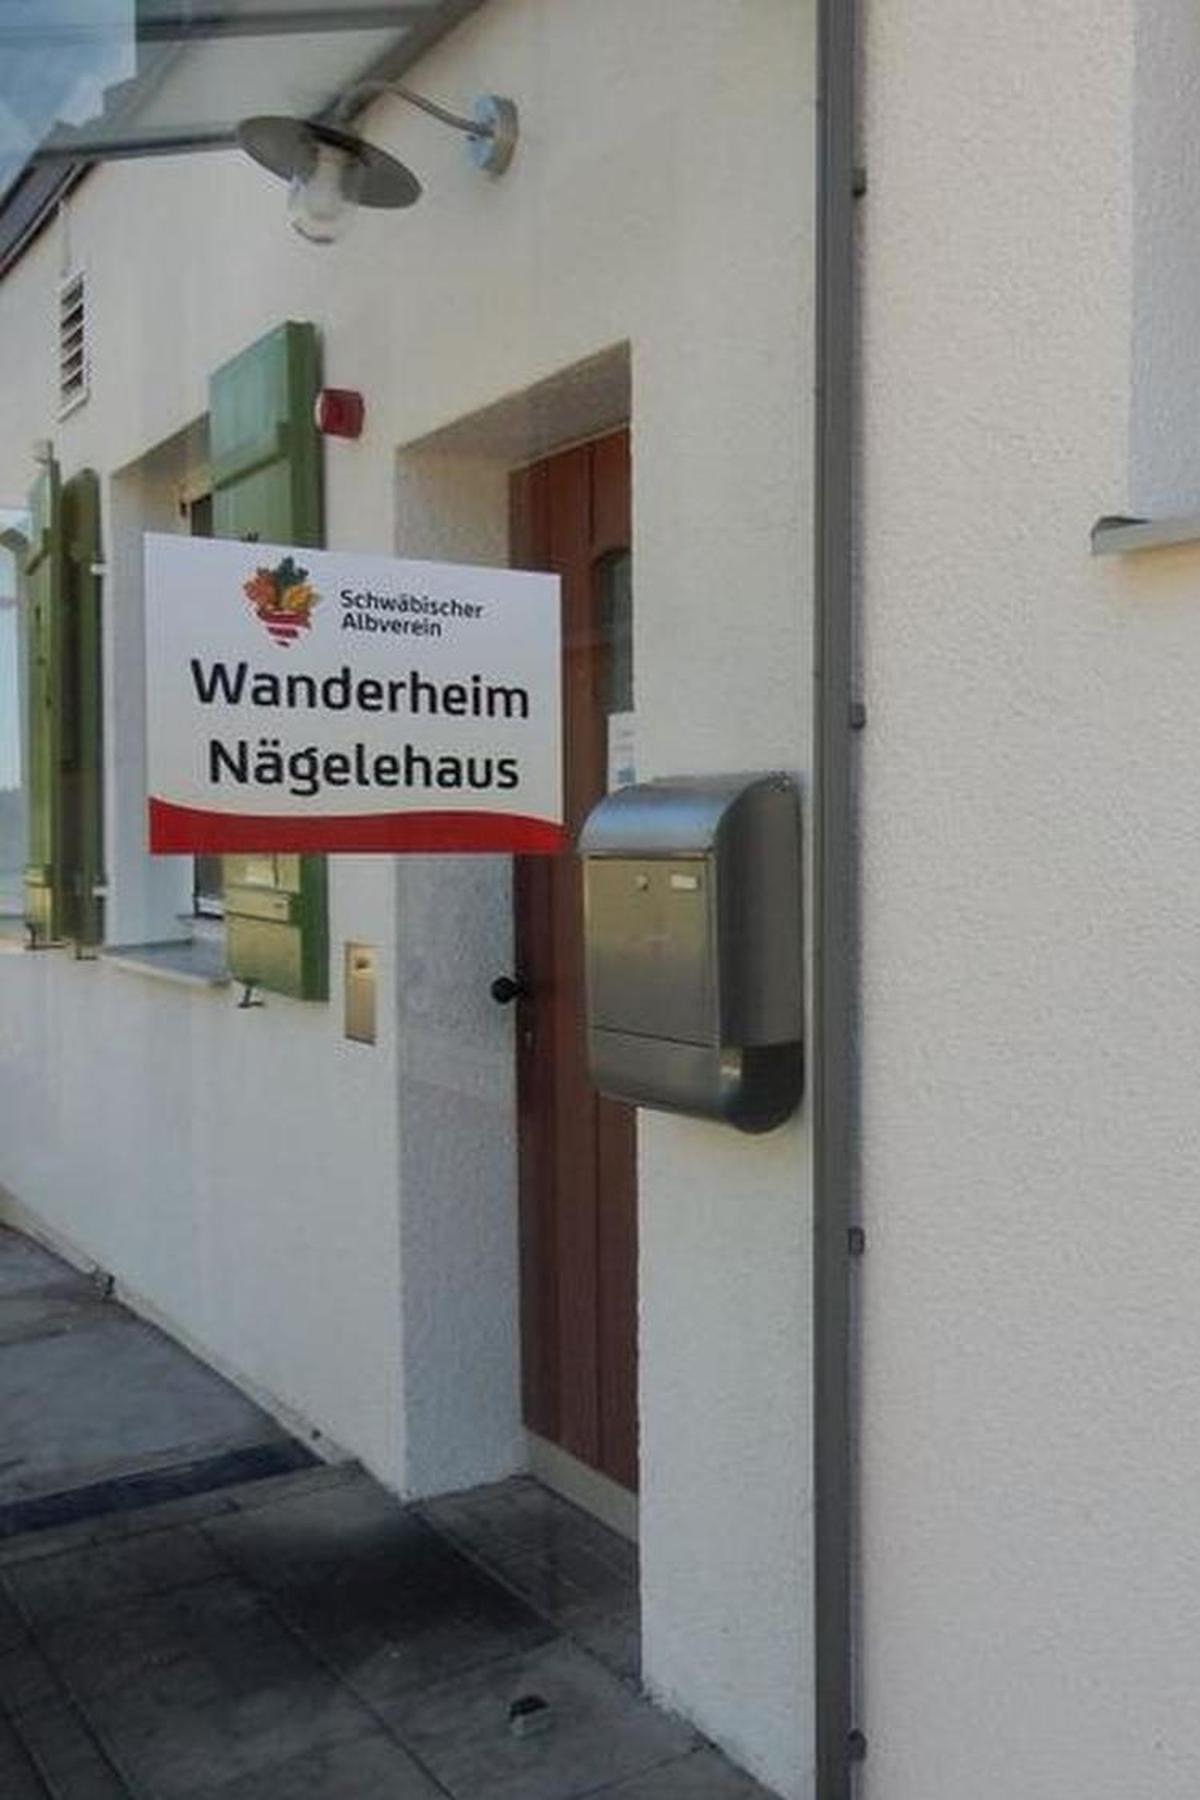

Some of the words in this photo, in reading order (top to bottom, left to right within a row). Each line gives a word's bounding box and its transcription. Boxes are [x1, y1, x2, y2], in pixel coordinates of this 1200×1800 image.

[340, 588, 484, 620] Schwäbischer
[341, 612, 442, 638] Albverein
[190, 658, 530, 720] Wanderheim
[208, 738, 521, 796] Nägelehaus
